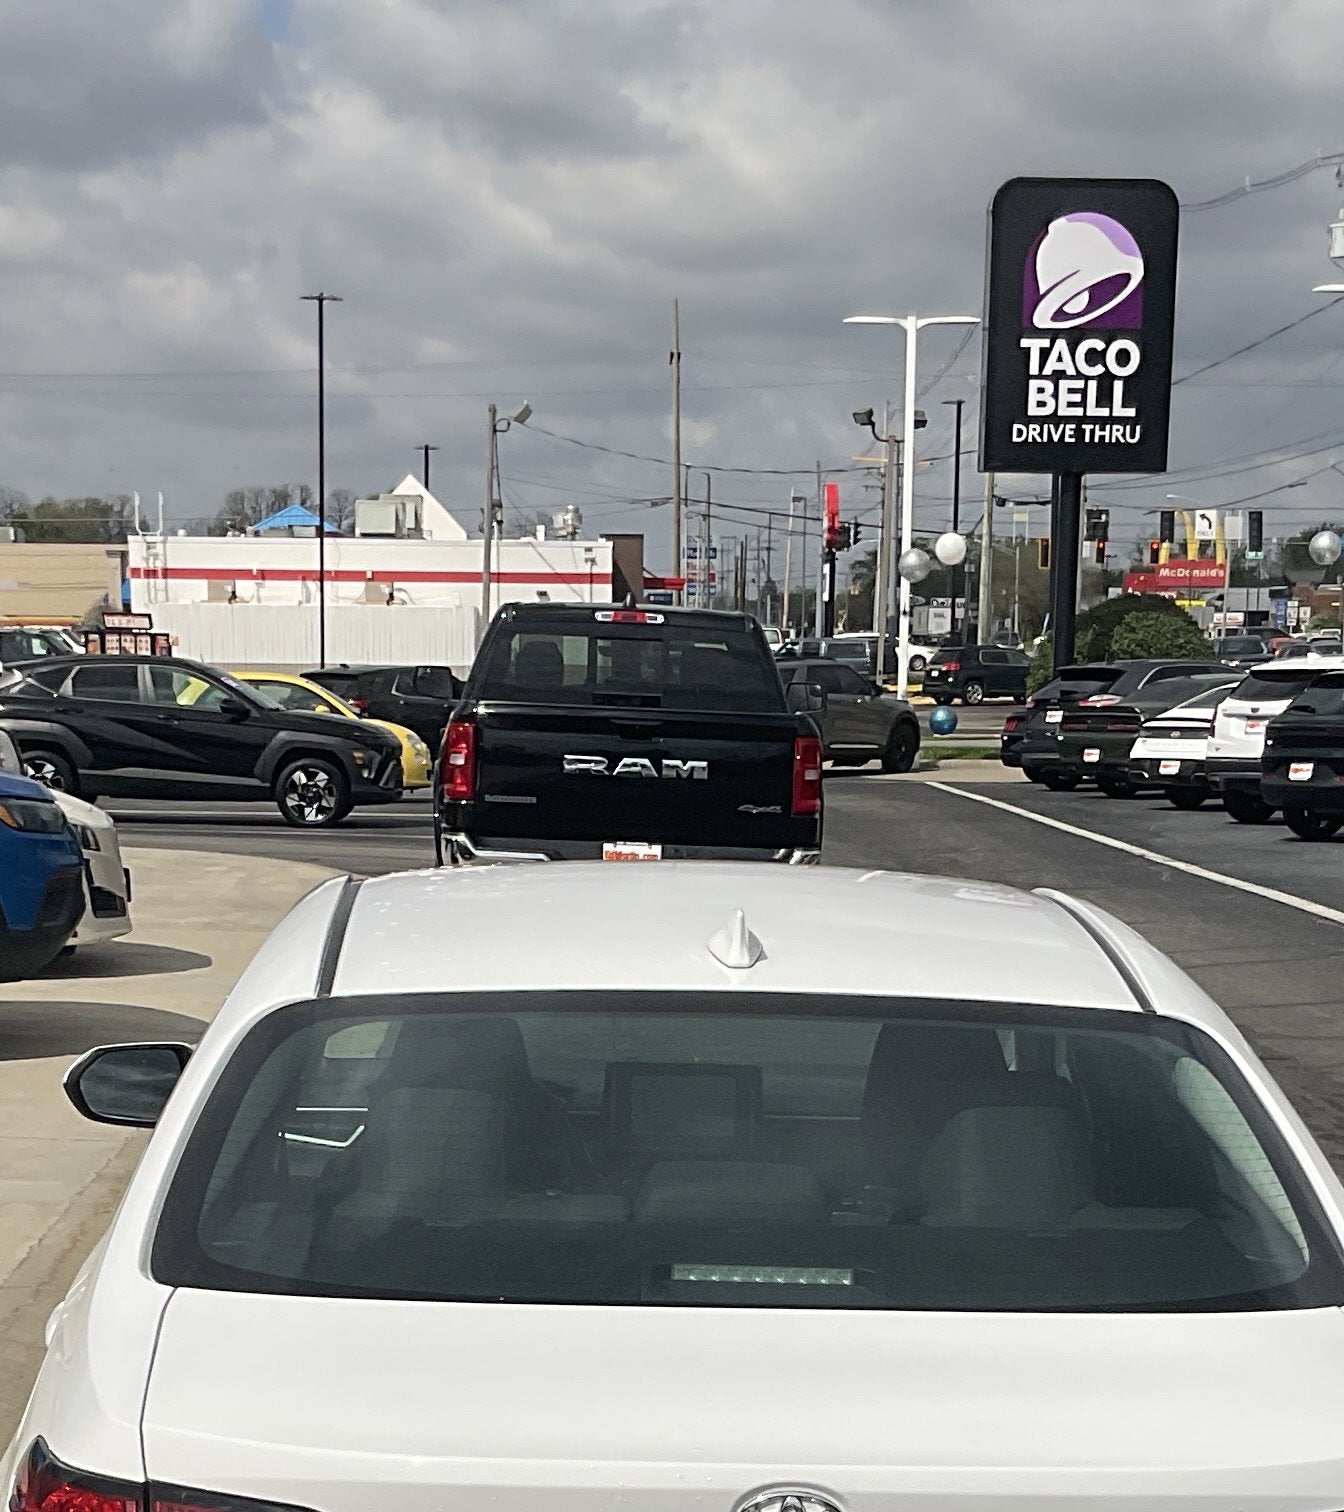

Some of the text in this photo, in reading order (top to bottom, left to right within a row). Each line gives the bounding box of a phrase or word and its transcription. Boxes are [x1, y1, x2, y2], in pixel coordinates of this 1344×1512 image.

[1020, 337, 1141, 377] TACO
[1027, 379, 1137, 417] BELL
[1012, 423, 1141, 444] DRIVE THRU
[1159, 567, 1225, 578] McDonald's
[562, 754, 708, 780] RAM
